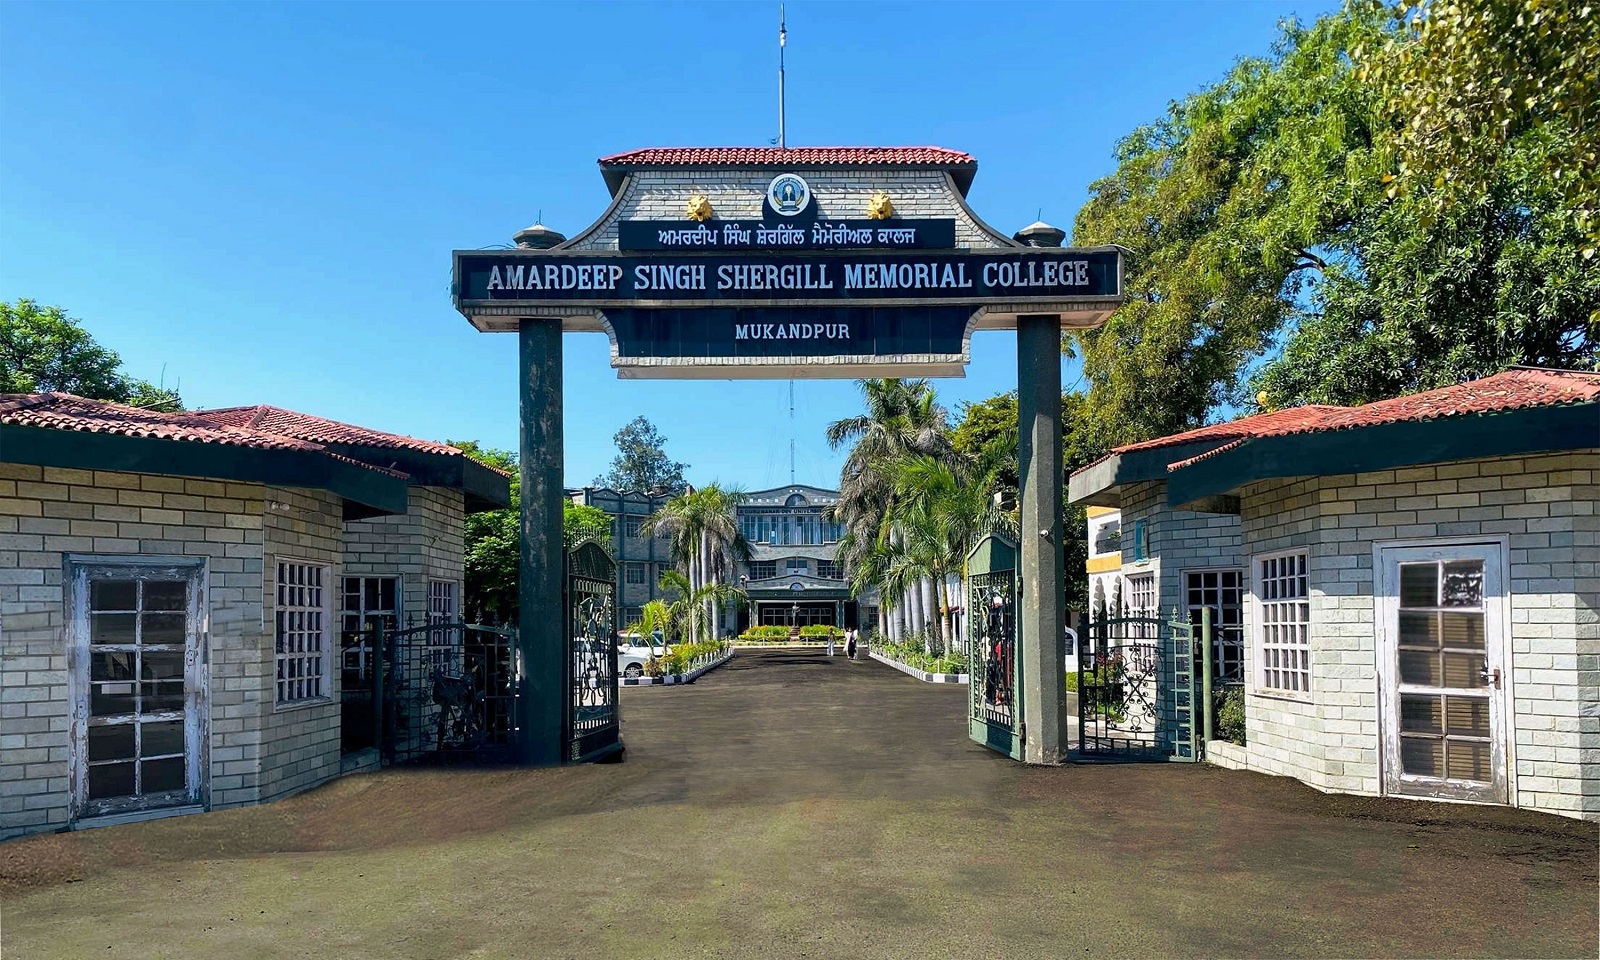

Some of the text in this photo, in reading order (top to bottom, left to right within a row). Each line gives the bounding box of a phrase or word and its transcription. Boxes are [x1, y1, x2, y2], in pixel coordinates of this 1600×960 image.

[658, 224, 718, 245] ਅਮਰਦੀਪ
[723, 223, 751, 245] ਸਿੰਘ
[812, 222, 873, 244] ਮੈਮੋਰੀਅਲ
[877, 228, 916, 244] ਕਾਲਜ
[487, 260, 1089, 290] AMARDEEP SINGH SHERGILL MEMORIAL COLLEGE
[735, 323, 850, 340] MUKANDPUR
